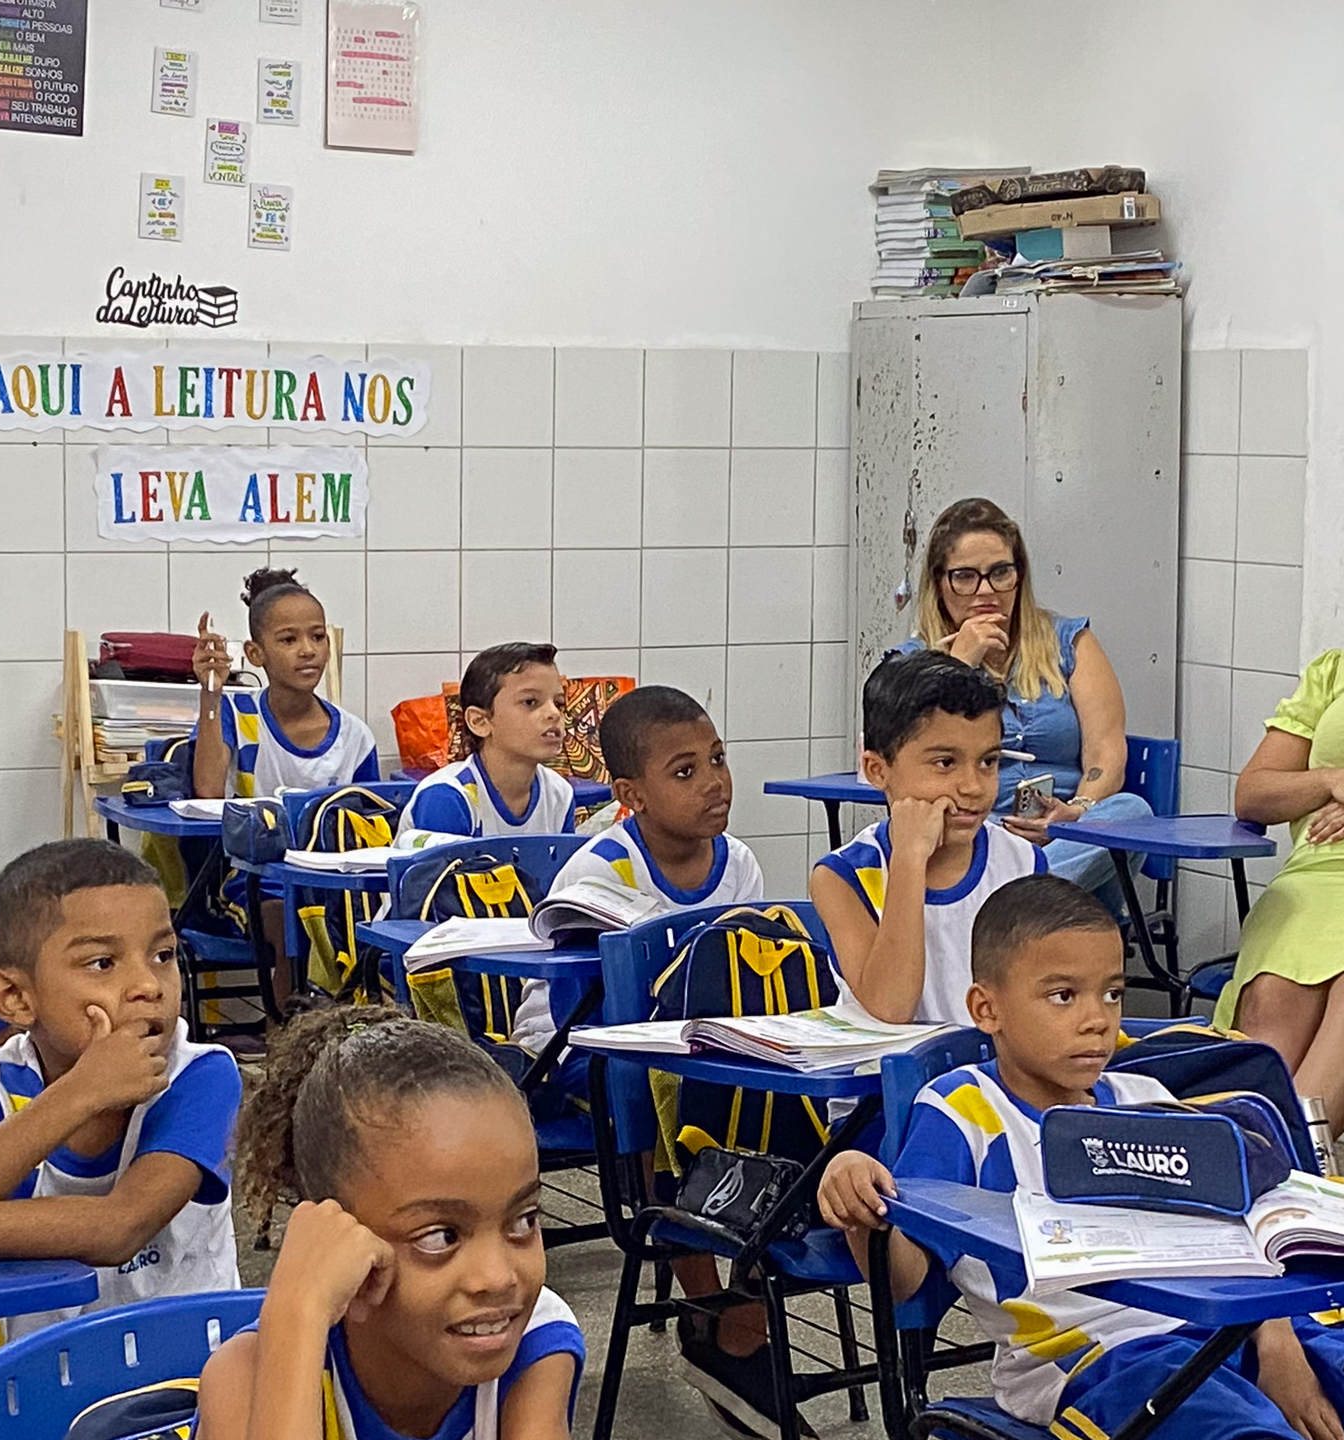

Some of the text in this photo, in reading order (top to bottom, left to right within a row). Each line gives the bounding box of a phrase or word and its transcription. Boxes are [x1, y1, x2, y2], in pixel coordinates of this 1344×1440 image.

[22, 9, 44, 18] ALTO
[32, 21, 72, 34] PESSOAS
[16, 31, 23, 40] O
[25, 32, 45, 42] BEM
[13, 43, 34, 53] MAIS
[34, 56, 60, 67] DURO
[25, 68, 63, 80] SONHOS
[34, 80, 41, 89] O
[43, 81, 78, 93] FUTURO
[36, 92, 42, 101] O
[45, 93, 69, 104] FOCO
[11, 101, 28, 111] SEU
[31, 102, 77, 116] TRABALHO
[11, 113, 77, 128] INTENSAMENTE
[208, 172, 246, 183] VONTADE
[106, 266, 199, 301] Cantinho
[96, 297, 199, 328] da Leitura
[105, 365, 132, 417] A
[153, 366, 326, 421] LEITURA
[342, 372, 414, 425] NOS
[111, 470, 352, 524] LEVA ALEM
[1109, 1150, 1189, 1177] LAURO
